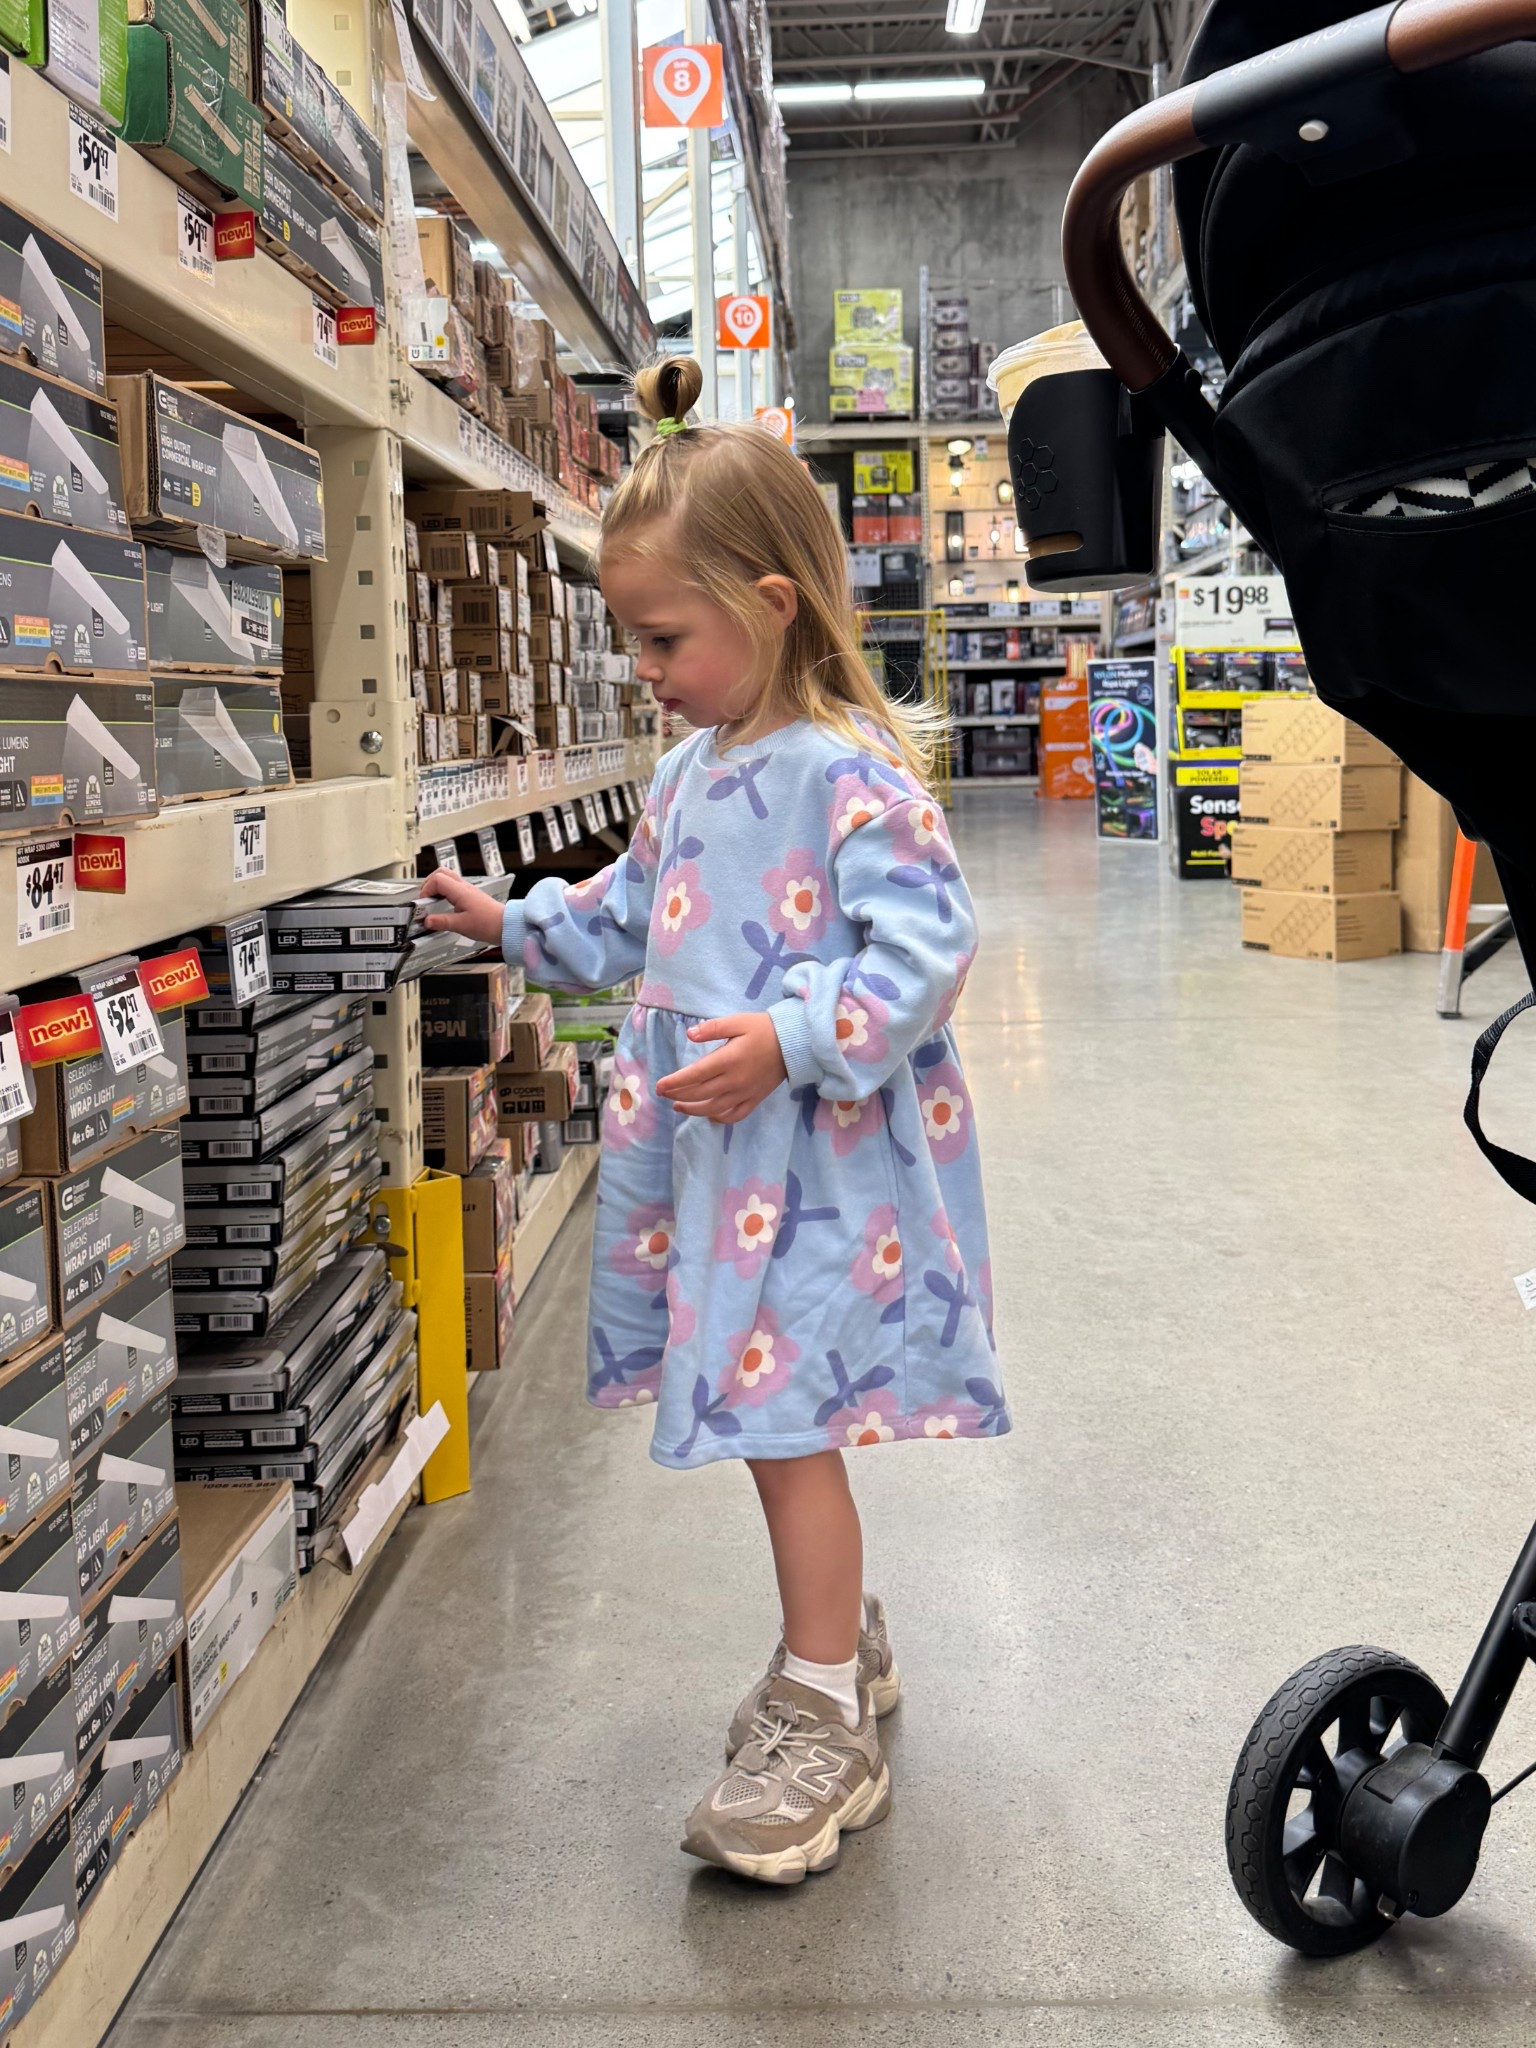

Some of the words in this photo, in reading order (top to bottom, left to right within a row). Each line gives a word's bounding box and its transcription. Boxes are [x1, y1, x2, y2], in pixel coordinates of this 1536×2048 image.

[673, 70, 691, 92] 8
[217, 221, 252, 245] new!
[340, 315, 372, 333] new!
[734, 311, 754, 325] 10
[161, 434, 173, 447] HIGH
[173, 439, 191, 454] OUTPUT
[161, 447, 191, 469] COMMERCIAL
[191, 456, 204, 474] WRAP
[204, 463, 217, 478] LIGHT
[0, 573, 12, 587] ENS
[1193, 585, 1269, 615] $1998
[3, 736, 29, 750] LUMENS
[0, 756, 16, 773] GHT
[24, 845, 35, 854] WRAP
[46, 840, 60, 850] LUMENS
[78, 848, 122, 872] new!
[278, 935, 297, 944] LED
[149, 959, 200, 995] new!
[29, 1006, 93, 1046] new!
[68, 1060, 104, 1083] SELECTABLE
[69, 1079, 92, 1100] LUMENS
[165, 1091, 176, 1105] LED
[513, 1086, 545, 1095] COOPER
[70, 1095, 92, 1119] WRAP
[93, 1084, 116, 1111] LIGHT
[63, 1209, 99, 1240] SELECTABLE
[64, 1232, 88, 1257] LUMENS
[163, 1231, 173, 1246] LED
[64, 1250, 87, 1276] WRAP
[89, 1233, 112, 1261] LIGHT
[21, 1316, 34, 1334] LED
[67, 1355, 96, 1390] ELECTABLE
[67, 1381, 86, 1406] UMENS
[88, 1378, 109, 1408] LIGHT
[180, 1437, 199, 1447] LED
[45, 1474, 58, 1492] LED
[74, 1497, 97, 1530] ECTABLE
[75, 1525, 87, 1545] ENS
[77, 1543, 87, 1564] AP
[88, 1518, 109, 1552] LIGHT
[56, 1630, 68, 1650] LED
[74, 1641, 108, 1691] SELECTABLE
[75, 1671, 97, 1707] LUMENS
[76, 1690, 98, 1725] WRAP
[99, 1660, 120, 1697] LIGHT
[49, 1786, 63, 1808] LED
[72, 1788, 103, 1839] ELECTABLE
[93, 1805, 114, 1846] LIGHT
[74, 1821, 92, 1856] MENS
[51, 1940, 64, 1963] LED
